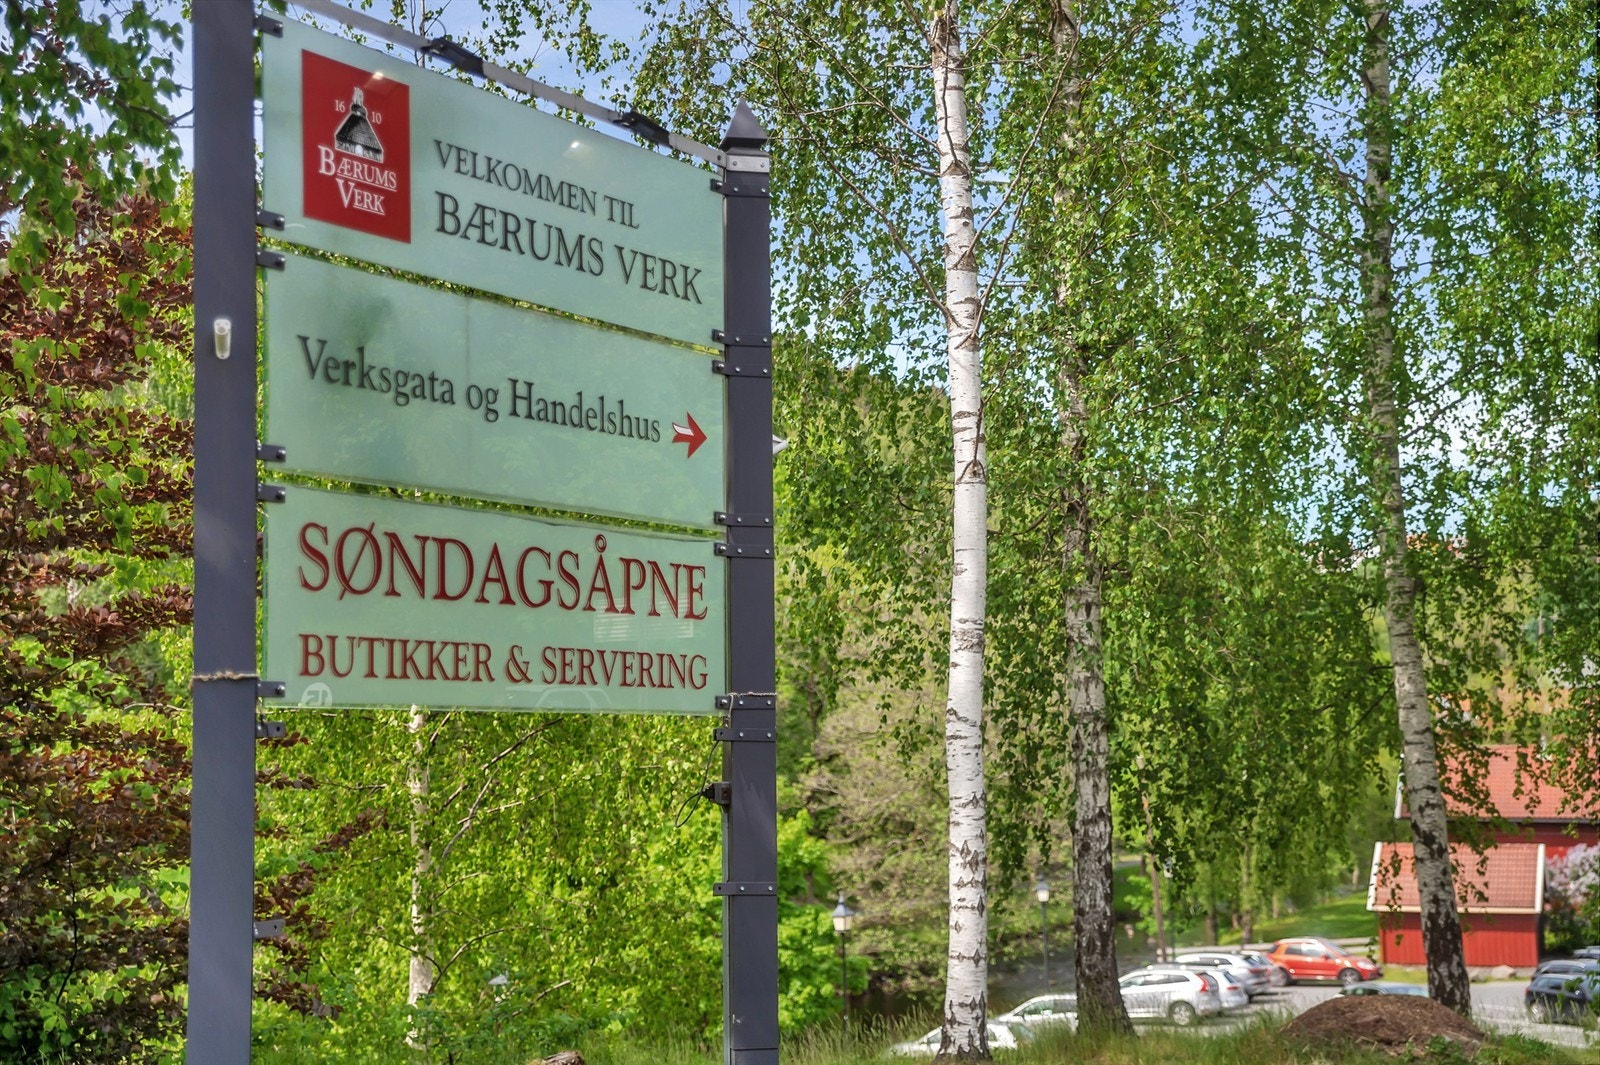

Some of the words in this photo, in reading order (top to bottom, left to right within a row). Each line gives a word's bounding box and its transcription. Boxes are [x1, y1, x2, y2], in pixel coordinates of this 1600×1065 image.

[335, 99, 346, 113] 16
[371, 111, 382, 125] 10
[318, 145, 397, 190] BÆRUMS
[336, 177, 385, 214] VERK
[434, 139, 597, 216] VELKOMMEN
[603, 196, 640, 230] TIL
[435, 191, 604, 277] BÆRUMS
[613, 245, 702, 304] VERK
[297, 335, 456, 407] Verksgata
[466, 384, 500, 423] og
[509, 378, 661, 443] Handelshus
[299, 522, 709, 621] SØNDAGSÅPNE
[299, 633, 496, 683] BUTIKKER
[505, 644, 534, 684] &
[541, 645, 709, 690] SERVERING
